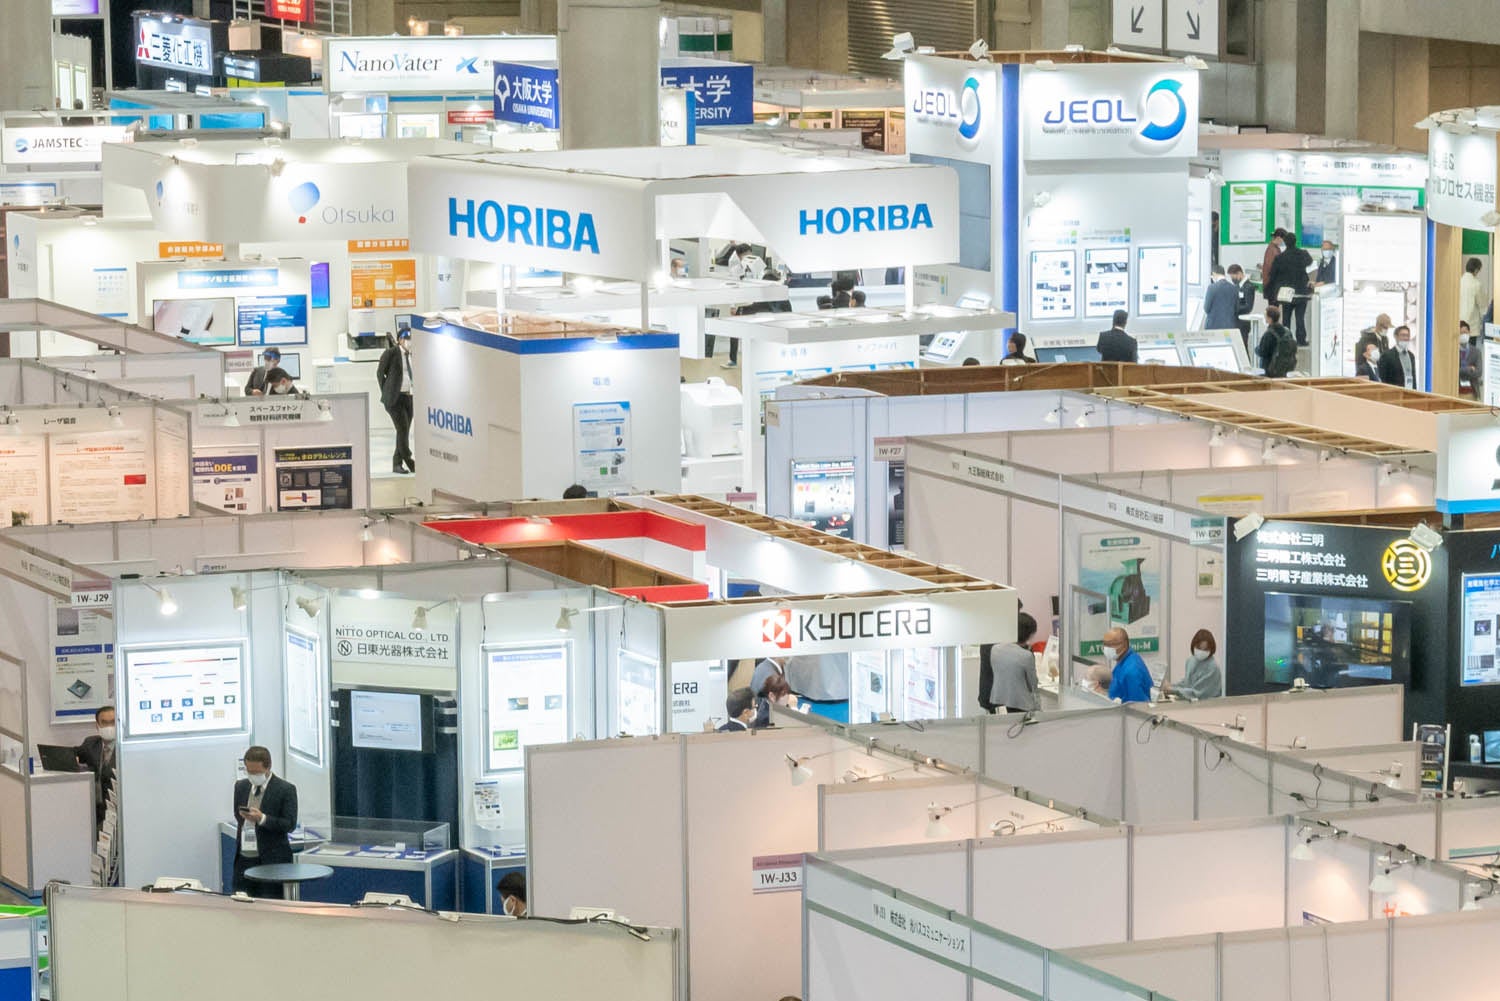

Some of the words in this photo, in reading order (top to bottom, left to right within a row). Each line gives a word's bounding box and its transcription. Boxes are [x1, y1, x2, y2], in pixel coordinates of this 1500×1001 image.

[512, 76, 553, 105] 大阪大学
[912, 90, 957, 118] JEOL
[1043, 99, 1137, 124] JEOL
[694, 106, 731, 120] ERSITY
[32, 137, 83, 149] JAMSTEC
[322, 204, 395, 224] Otsuka
[799, 202, 934, 236] HORIBA
[448, 197, 601, 255] HORIBA
[1348, 223, 1371, 233] SEM
[427, 406, 473, 437] HORIBA
[1256, 531, 1325, 547] 株式会社三明
[77, 593, 109, 603] 1W-J29
[335, 628, 363, 637] NITTO
[366, 629, 406, 640] OPTICAL
[798, 608, 932, 643] KYOCERA
[357, 643, 449, 660] 日東光器株式会社
[672, 681, 699, 695] ERA
[761, 871, 798, 884] 1W-J33
